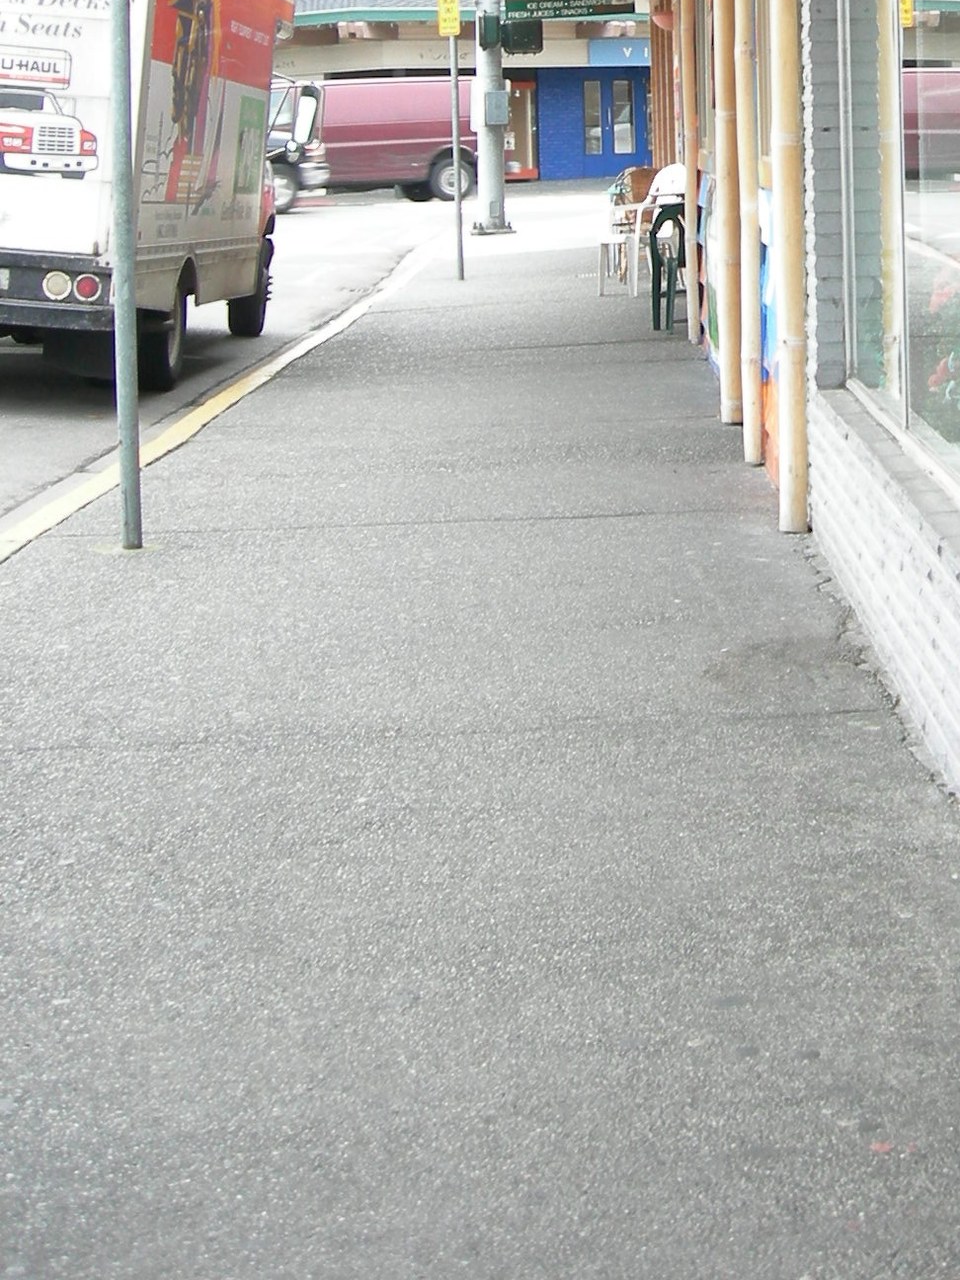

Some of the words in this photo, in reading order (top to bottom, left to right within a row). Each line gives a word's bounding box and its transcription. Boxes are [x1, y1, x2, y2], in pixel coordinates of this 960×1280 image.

[507, 10, 530, 19] FRESH
[14, 12, 83, 39] Seats
[1, 57, 61, 75] U-HAUL
